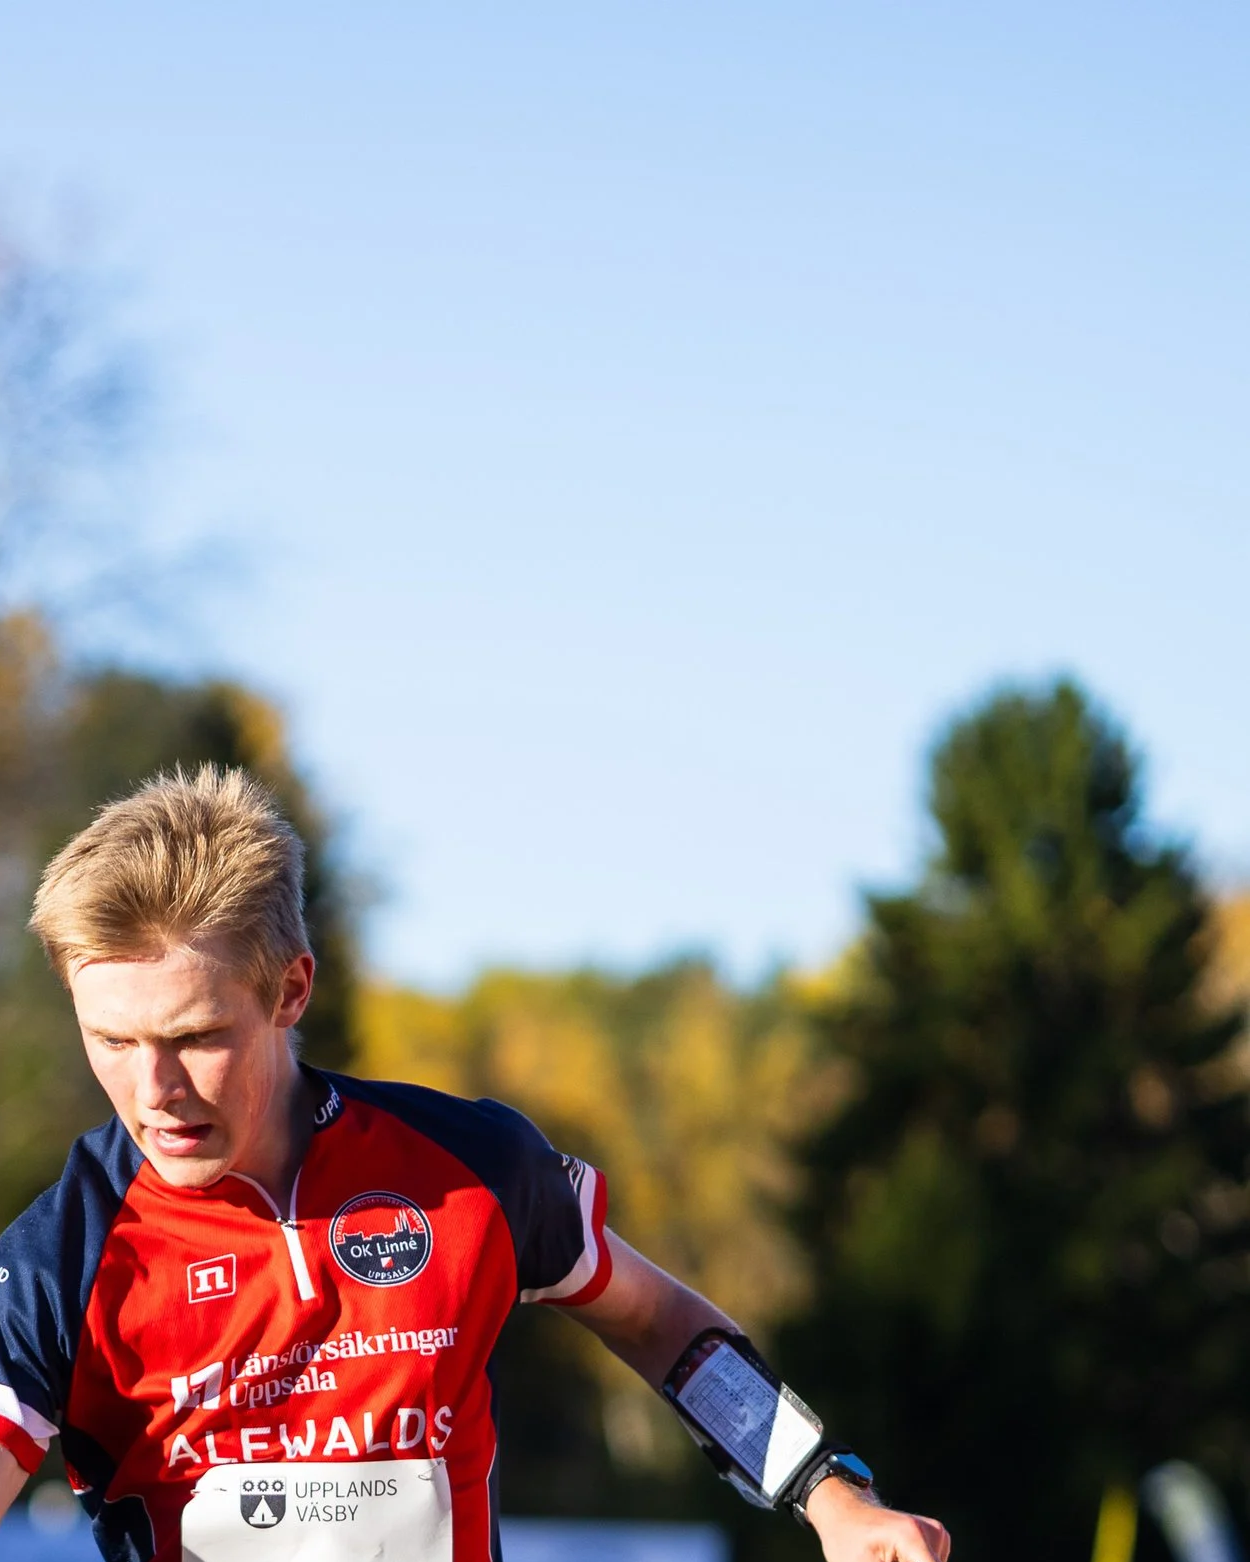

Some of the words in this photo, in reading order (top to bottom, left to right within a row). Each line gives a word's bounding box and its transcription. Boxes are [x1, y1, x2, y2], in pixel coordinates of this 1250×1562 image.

[350, 1244, 373, 1258] OK
[376, 1236, 418, 1256] Linné
[367, 1265, 411, 1280] UPPSALA
[231, 1327, 458, 1379] Länsförsäkringar
[229, 1366, 338, 1408] Uppsala
[168, 1405, 453, 1467] ALEWALDS
[295, 1478, 398, 1498] UPPLANDS
[295, 1502, 359, 1522] VÄSBY
